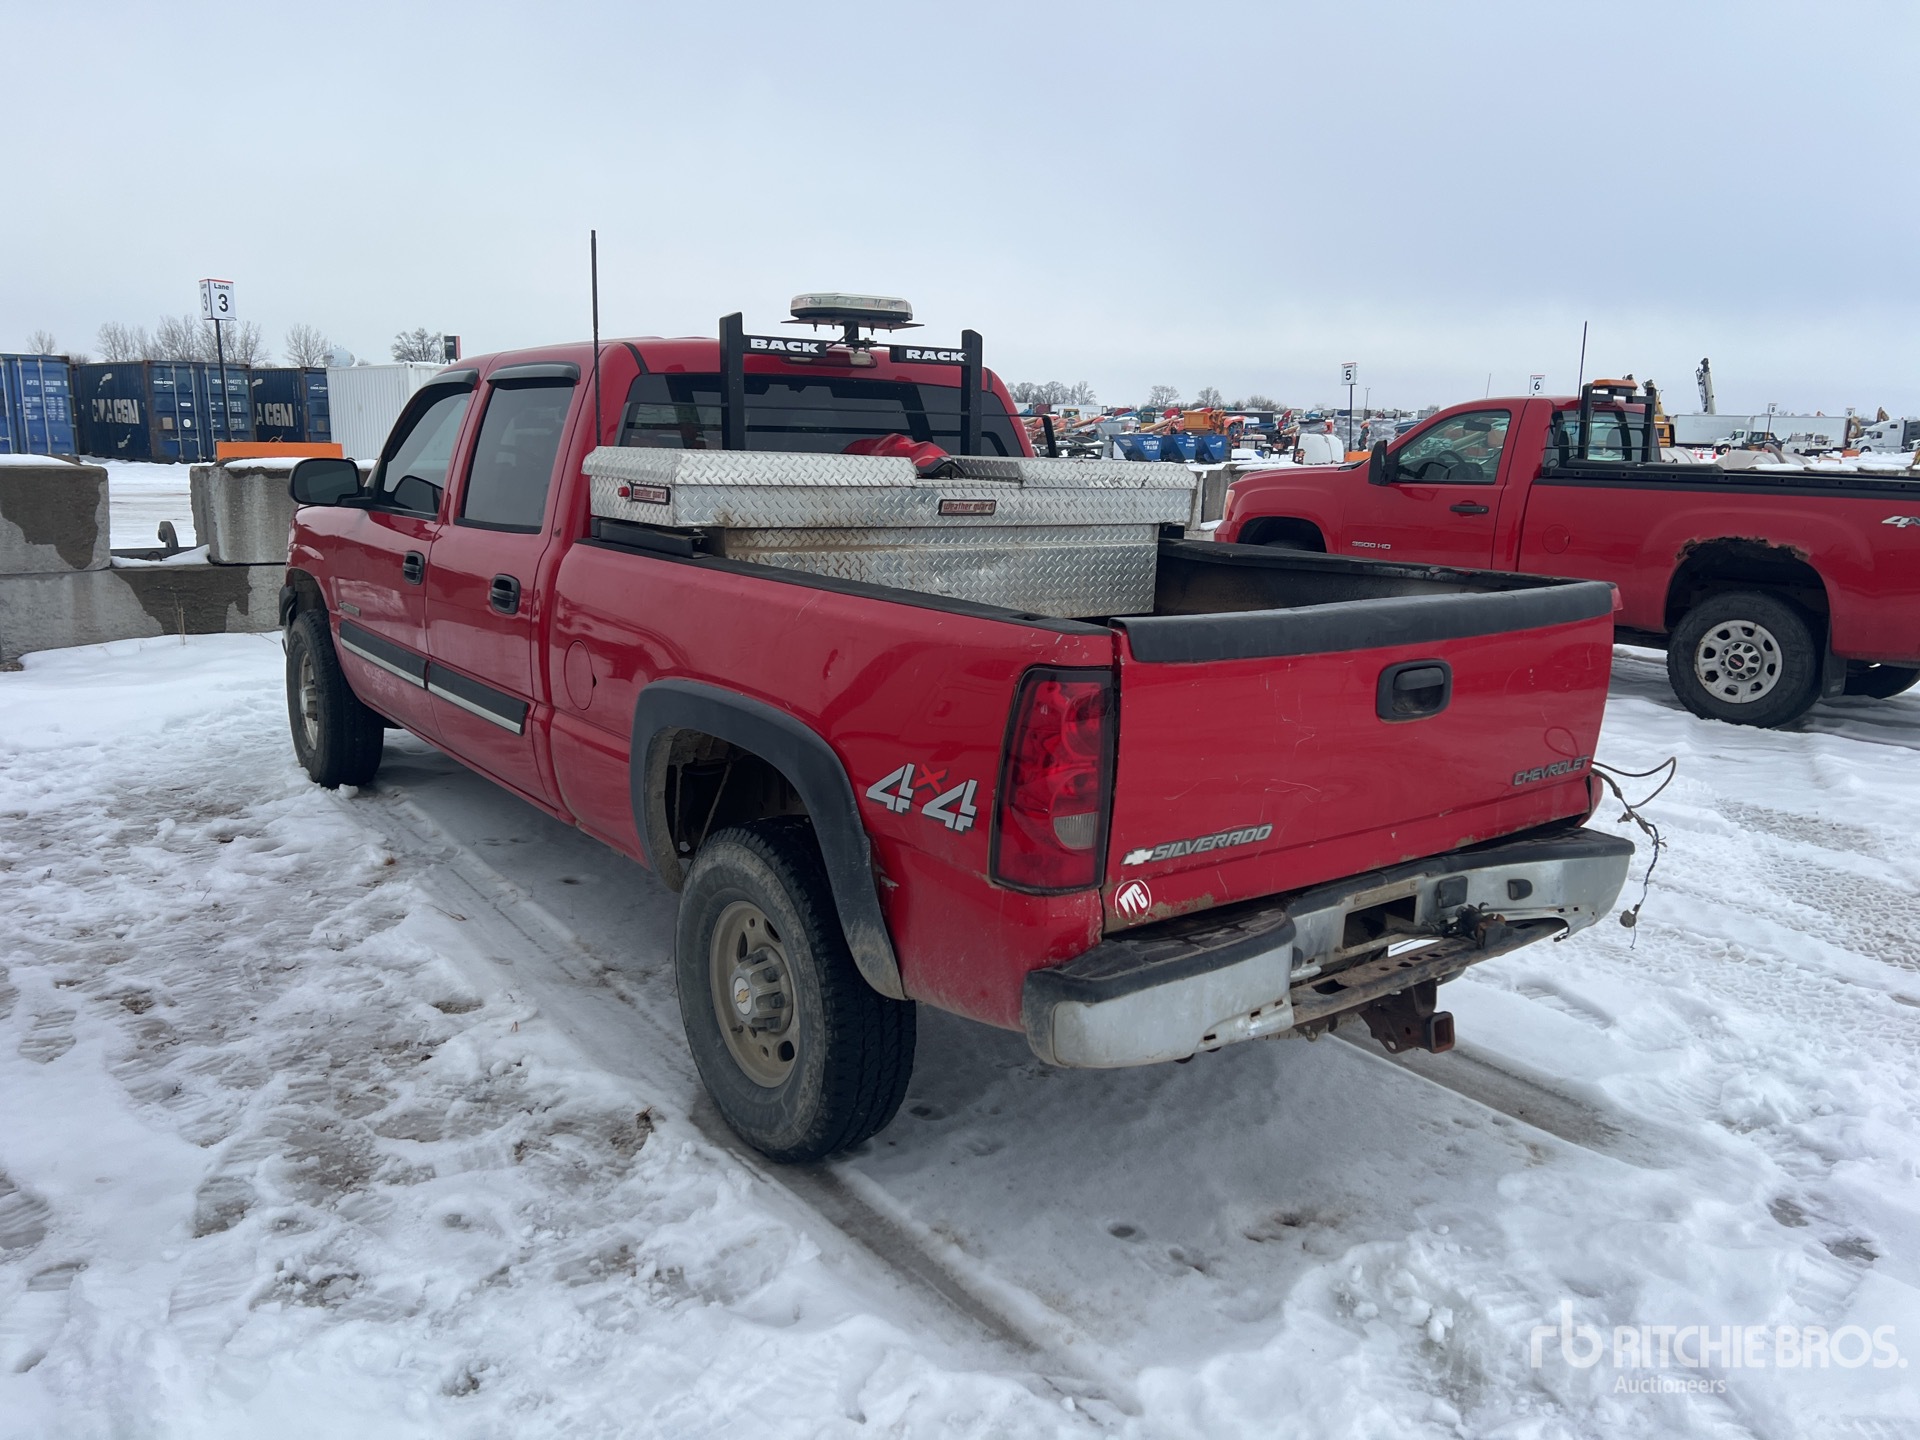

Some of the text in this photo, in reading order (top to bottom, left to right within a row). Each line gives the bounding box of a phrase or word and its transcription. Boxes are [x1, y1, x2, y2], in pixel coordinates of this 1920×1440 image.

[203, 293, 209, 311] 3
[218, 293, 229, 312] 3
[750, 338, 964, 362] BACK RACK
[1345, 370, 1352, 380] 5
[1534, 381, 1540, 390] 6
[113, 399, 140, 424] CGM
[264, 403, 294, 427] CGM
[1351, 541, 1376, 549] 3500
[1513, 754, 1591, 787] CHEVROLET
[1150, 823, 1274, 862] SILVERADO
